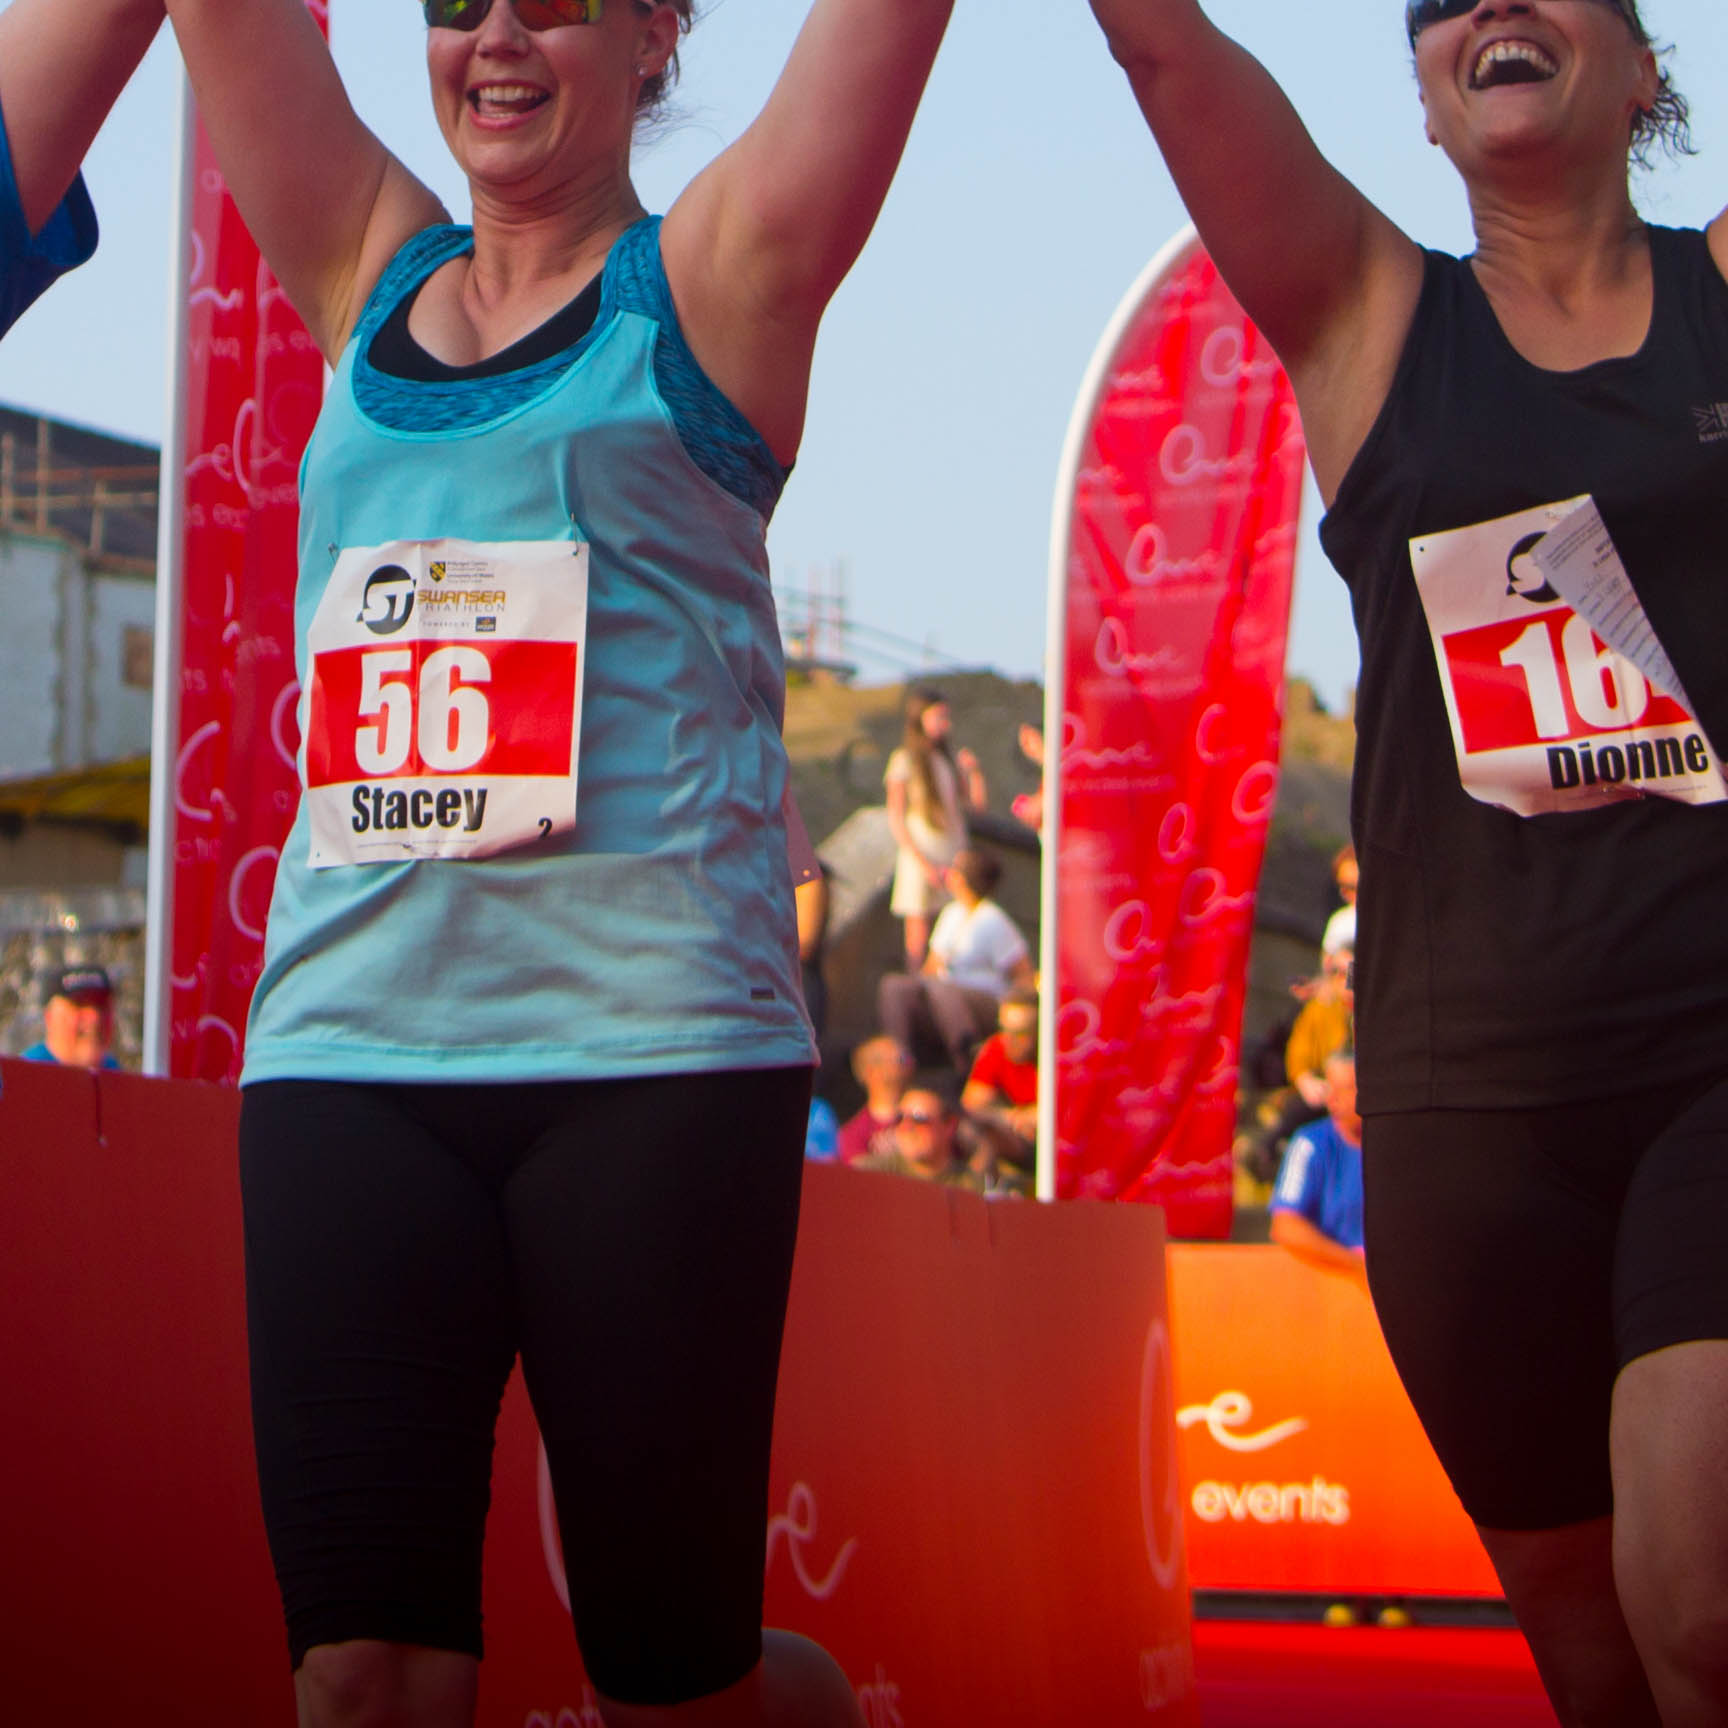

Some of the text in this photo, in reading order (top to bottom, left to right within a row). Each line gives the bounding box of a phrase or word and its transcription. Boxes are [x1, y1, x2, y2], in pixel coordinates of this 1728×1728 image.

[417, 590, 506, 603] SWANSEA
[355, 646, 492, 775] 56
[1546, 733, 1710, 790] Dionne
[352, 785, 488, 832] Stacey
[538, 817, 552, 839] 2
[1191, 1475, 1351, 1526] events
